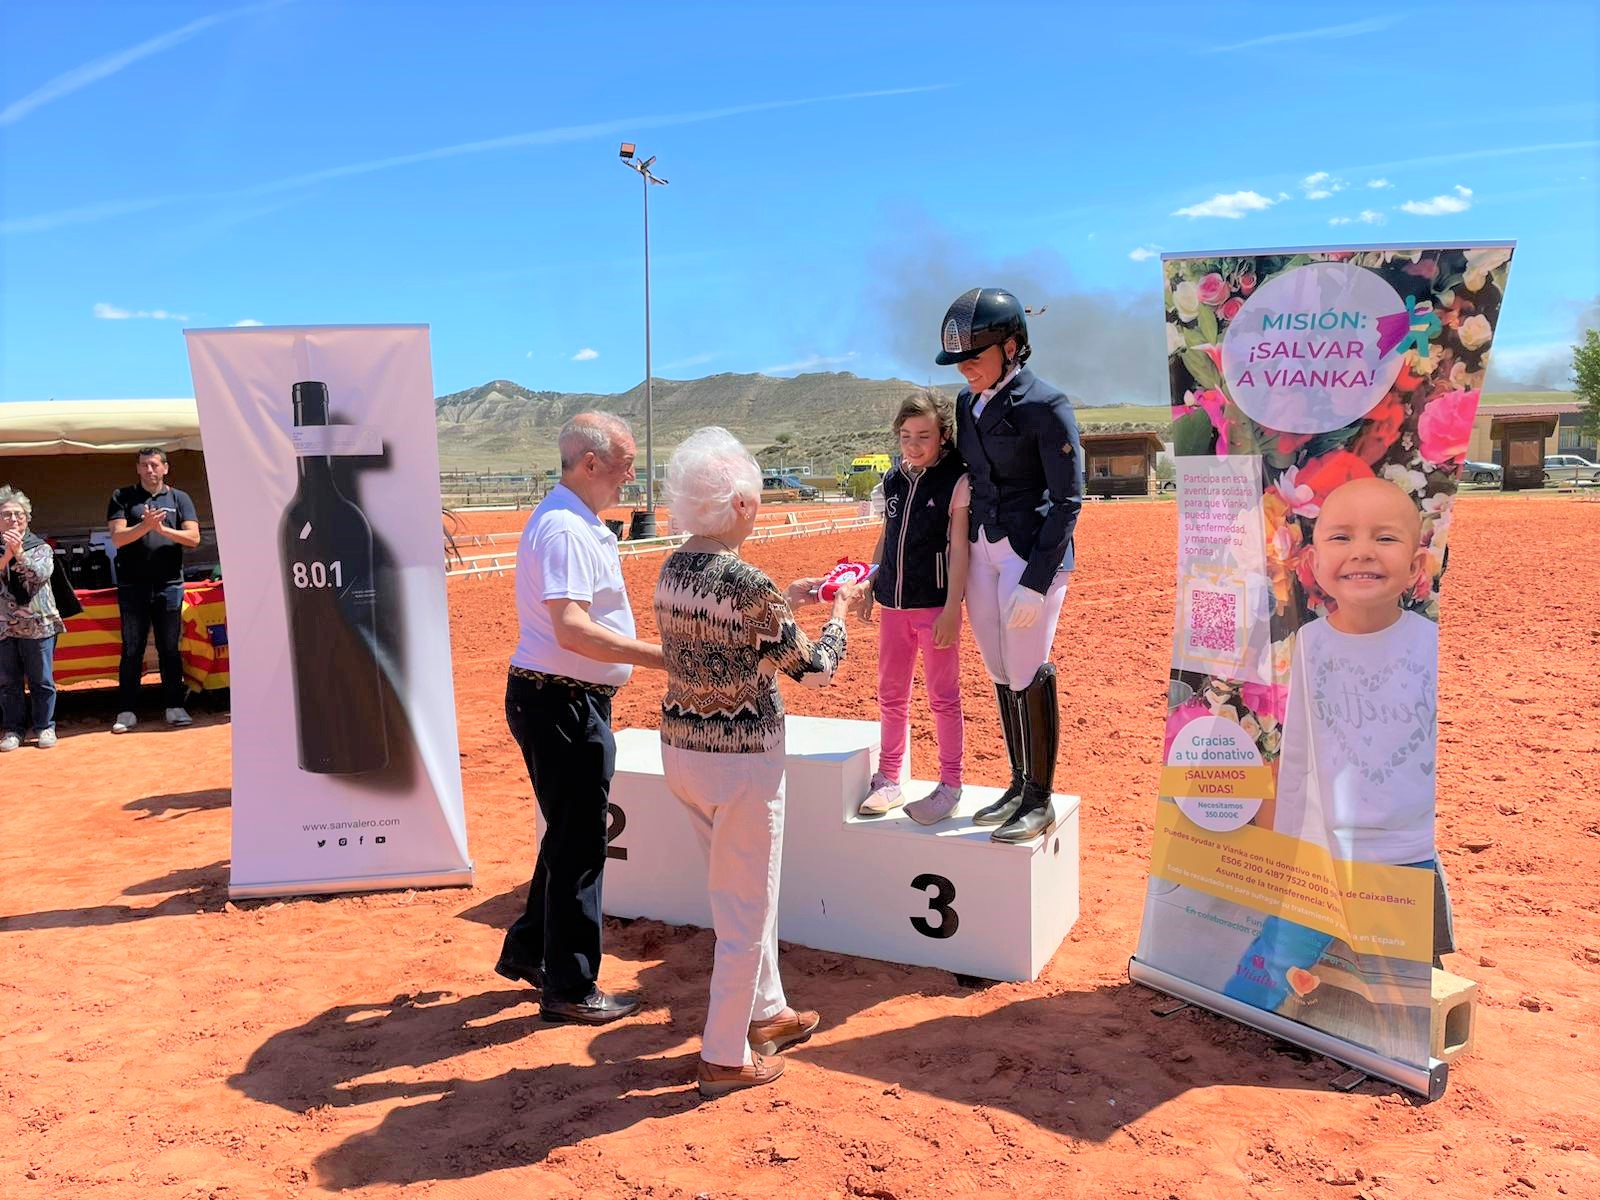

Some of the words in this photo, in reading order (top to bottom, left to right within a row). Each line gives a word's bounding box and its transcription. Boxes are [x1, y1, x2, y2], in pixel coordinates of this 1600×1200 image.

[1262, 308, 1367, 331] MISIÓN:
[1249, 341, 1364, 362] ¡SALVAR
[1236, 370, 1255, 387] A
[1264, 369, 1376, 388] VIANKA!
[1183, 474, 1220, 484] Participa
[1233, 475, 1248, 483] esta
[1184, 488, 1220, 496] aventura
[1221, 487, 1253, 496] solidaria
[1205, 501, 1220, 509] que
[1222, 500, 1248, 509] Vianka
[1184, 511, 1210, 520] pueda
[1213, 513, 1238, 521] vencer
[1196, 522, 1248, 535] enfermedad,
[1184, 536, 1190, 544] y
[1191, 536, 1232, 545] mantener
[1233, 538, 1243, 546] su
[1184, 546, 1214, 556] sonrisa
[292, 560, 343, 589] 8.0.1
[1191, 735, 1236, 747] Gracias
[1175, 752, 1183, 760] a
[1185, 750, 1198, 760] tu
[1201, 748, 1255, 760] donativo
[1185, 770, 1246, 781] ¡SALVAMOS
[1198, 784, 1234, 794] VIDAS!
[1198, 801, 1244, 809] Necesitamos
[1205, 810, 1239, 819] 350.000€
[302, 818, 400, 832] www.sanvalero.com
[605, 803, 628, 861] 2
[1164, 827, 1189, 841] Puedes
[1190, 836, 1215, 848] ayudar
[1223, 844, 1248, 858] Vianka
[1249, 854, 1264, 862] con
[1265, 857, 1274, 866] tu
[1275, 861, 1310, 877] donativo
[1312, 873, 1321, 881] en
[1346, 890, 1357, 898] de
[1359, 891, 1416, 906] CaixaBank:
[1221, 855, 1242, 867] ES06
[1243, 861, 1263, 874] 2100
[1265, 868, 1284, 880] 4187
[1286, 874, 1307, 888] 7522
[1308, 882, 1329, 895] 0010
[1216, 867, 1244, 881] Asunto
[1245, 876, 1256, 884] de
[1257, 878, 1265, 888] la
[1266, 881, 1325, 908] transferencia:
[909, 873, 959, 939] 3
[1185, 905, 1196, 915] En
[1290, 904, 1334, 924] tratamiento
[1371, 934, 1406, 947] España
